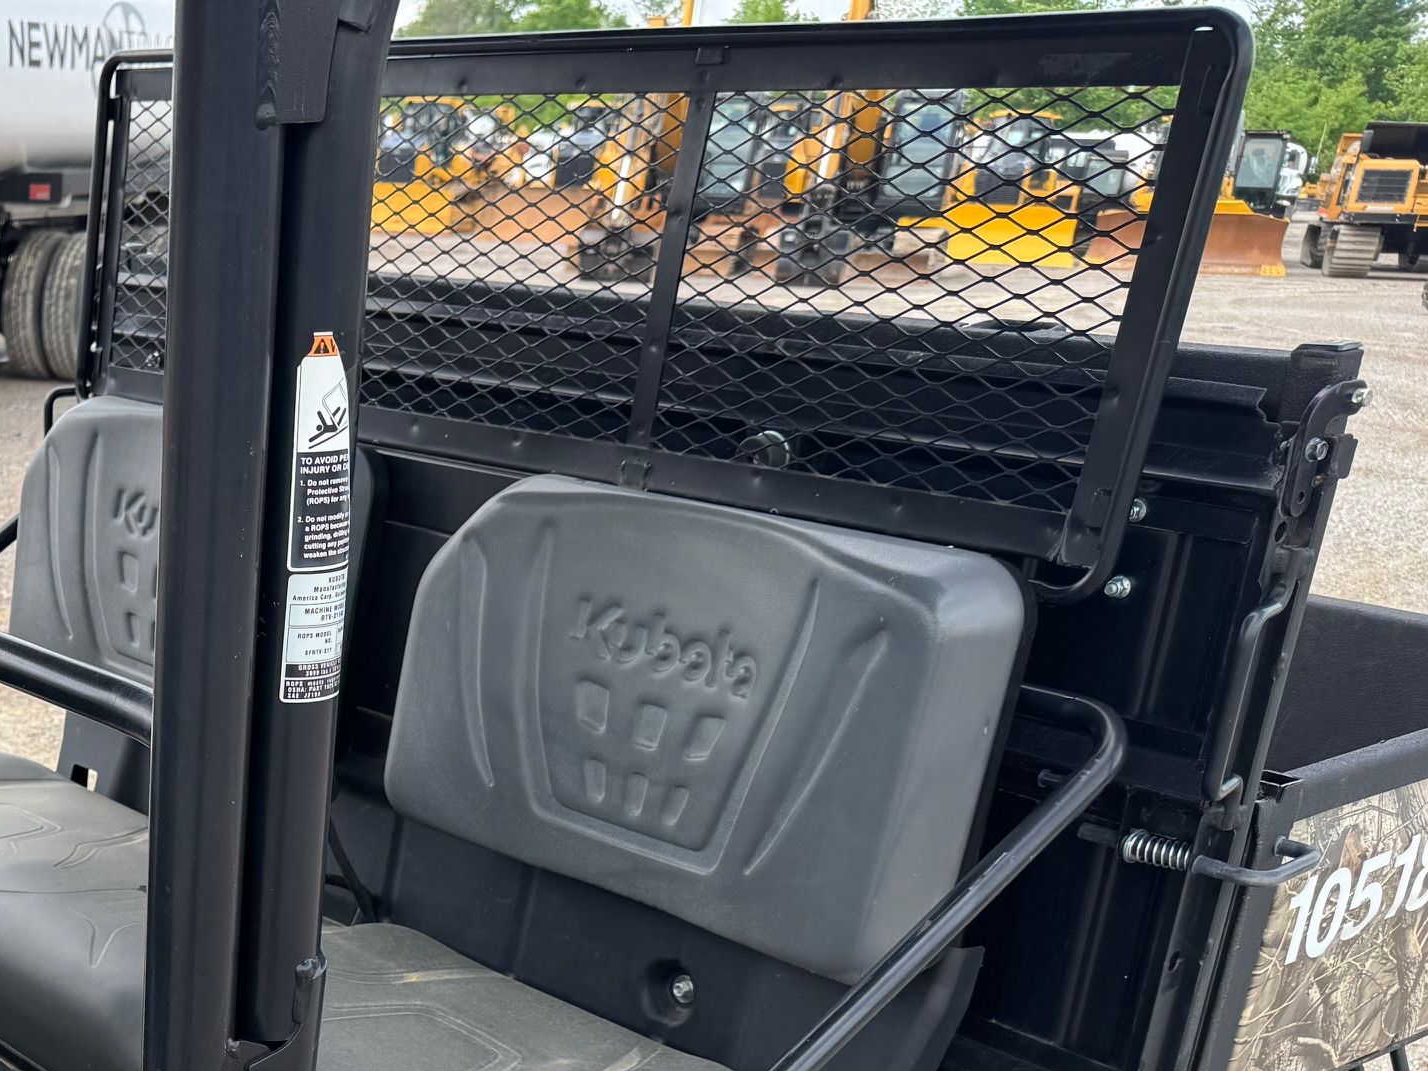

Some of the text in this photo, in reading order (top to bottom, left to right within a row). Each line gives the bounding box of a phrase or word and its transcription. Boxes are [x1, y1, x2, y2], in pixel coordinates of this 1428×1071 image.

[314, 456, 338, 464] AVOID
[300, 466, 330, 474] INJURY
[332, 464, 341, 472] OR
[307, 487, 338, 495] Protective
[307, 497, 330, 506] (ROPS)
[311, 523, 329, 531] ROPS
[305, 534, 332, 542] grinding,
[304, 542, 326, 550] cutting
[305, 606, 332, 614] MACHINE
[572, 596, 755, 698] Kubota
